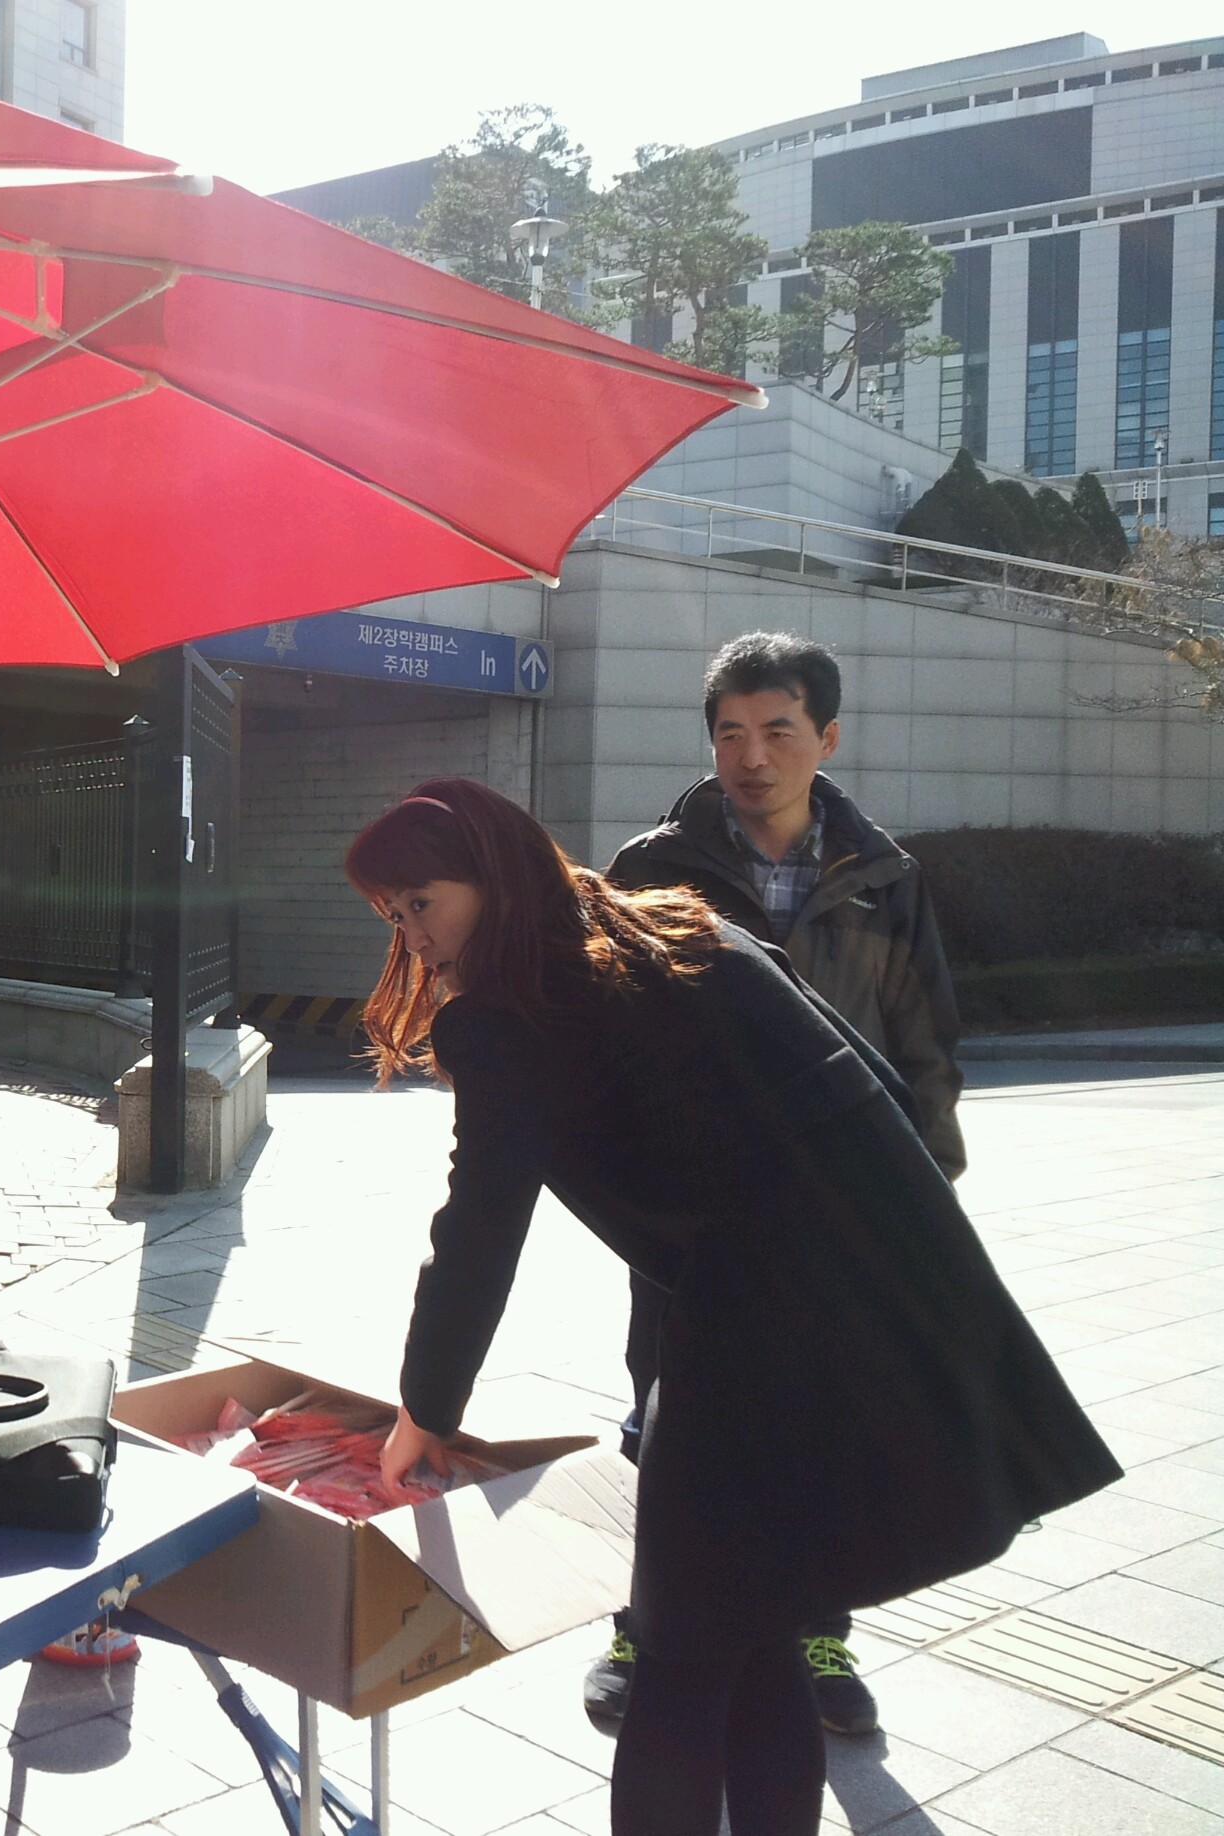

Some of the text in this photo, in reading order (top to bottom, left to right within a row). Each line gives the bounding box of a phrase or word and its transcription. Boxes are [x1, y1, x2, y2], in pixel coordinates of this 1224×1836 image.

[358, 624, 459, 655] 제2창학캠퍼스
[383, 655, 429, 678] 주차장
[481, 649, 496, 677] In
